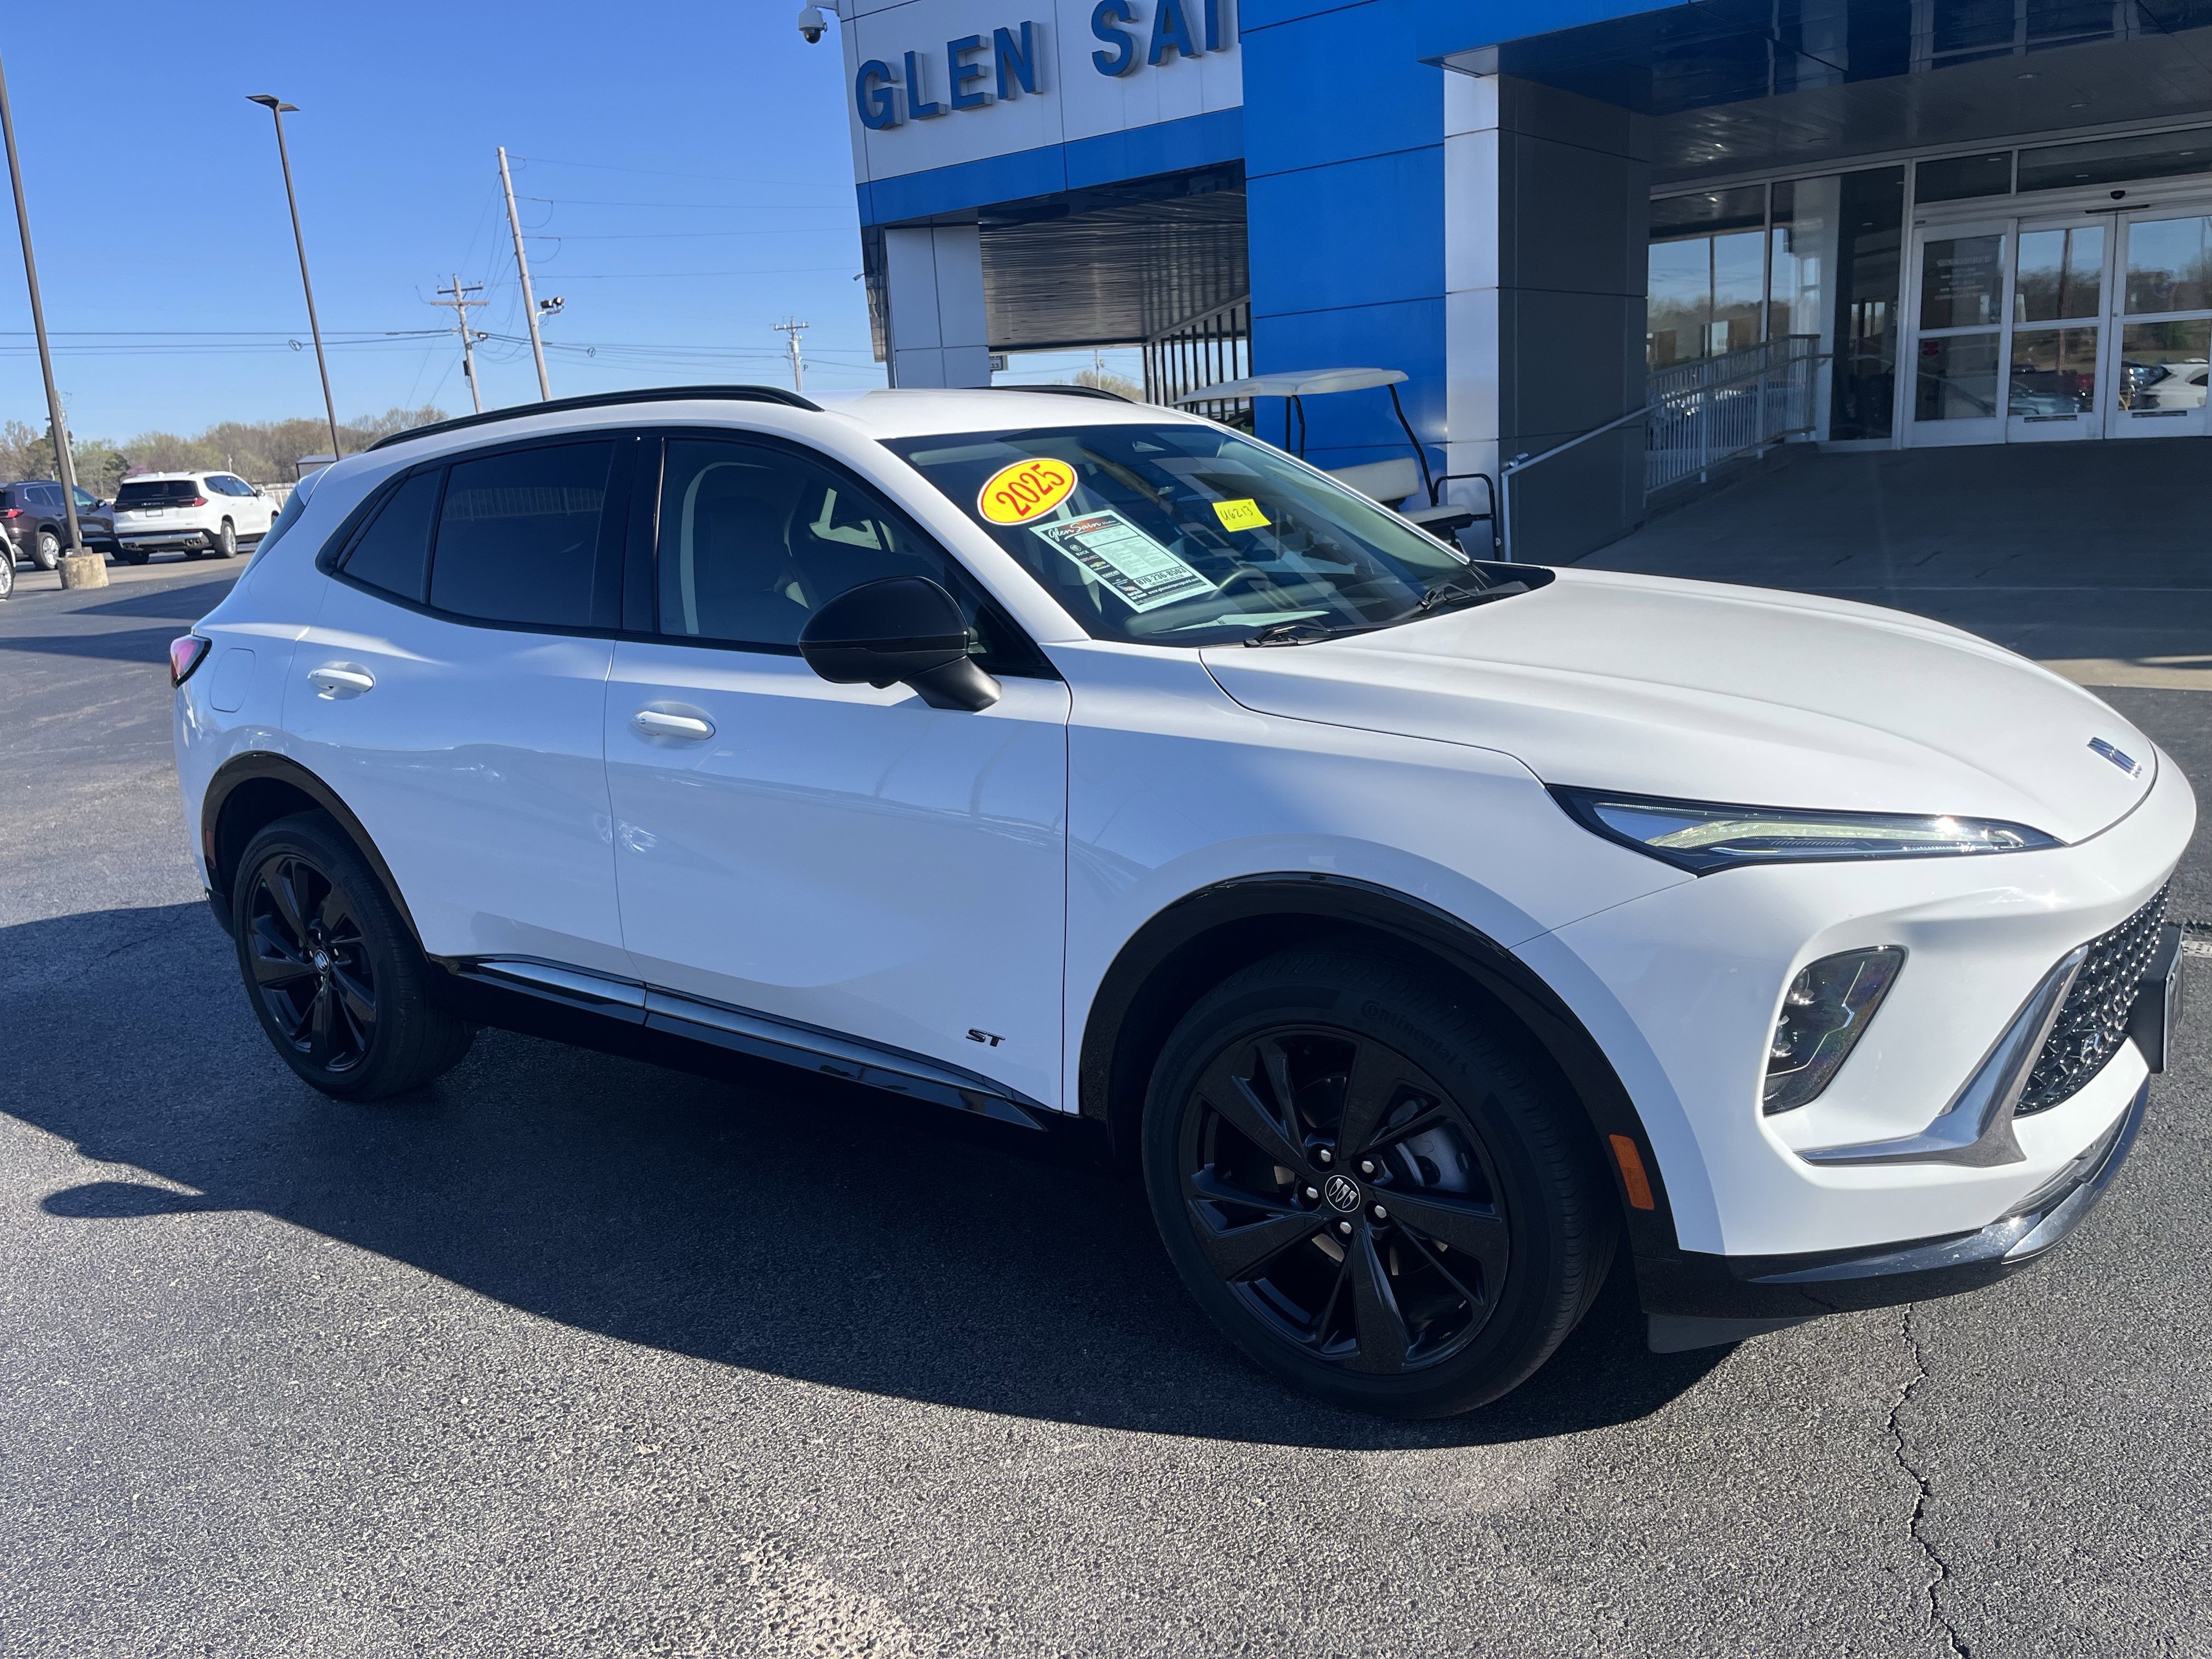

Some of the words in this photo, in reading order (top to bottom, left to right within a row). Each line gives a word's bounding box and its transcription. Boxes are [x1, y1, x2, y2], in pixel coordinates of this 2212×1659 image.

[856, 21, 1042, 131] GLEN
[996, 463, 1065, 517] 2025
[1048, 527, 1075, 542] Glen
[1070, 522, 1102, 533] Sain
[1136, 568, 1187, 585] 870-236-8503
[966, 1027, 1006, 1047] ST
[1360, 999, 1459, 1066] Continental
